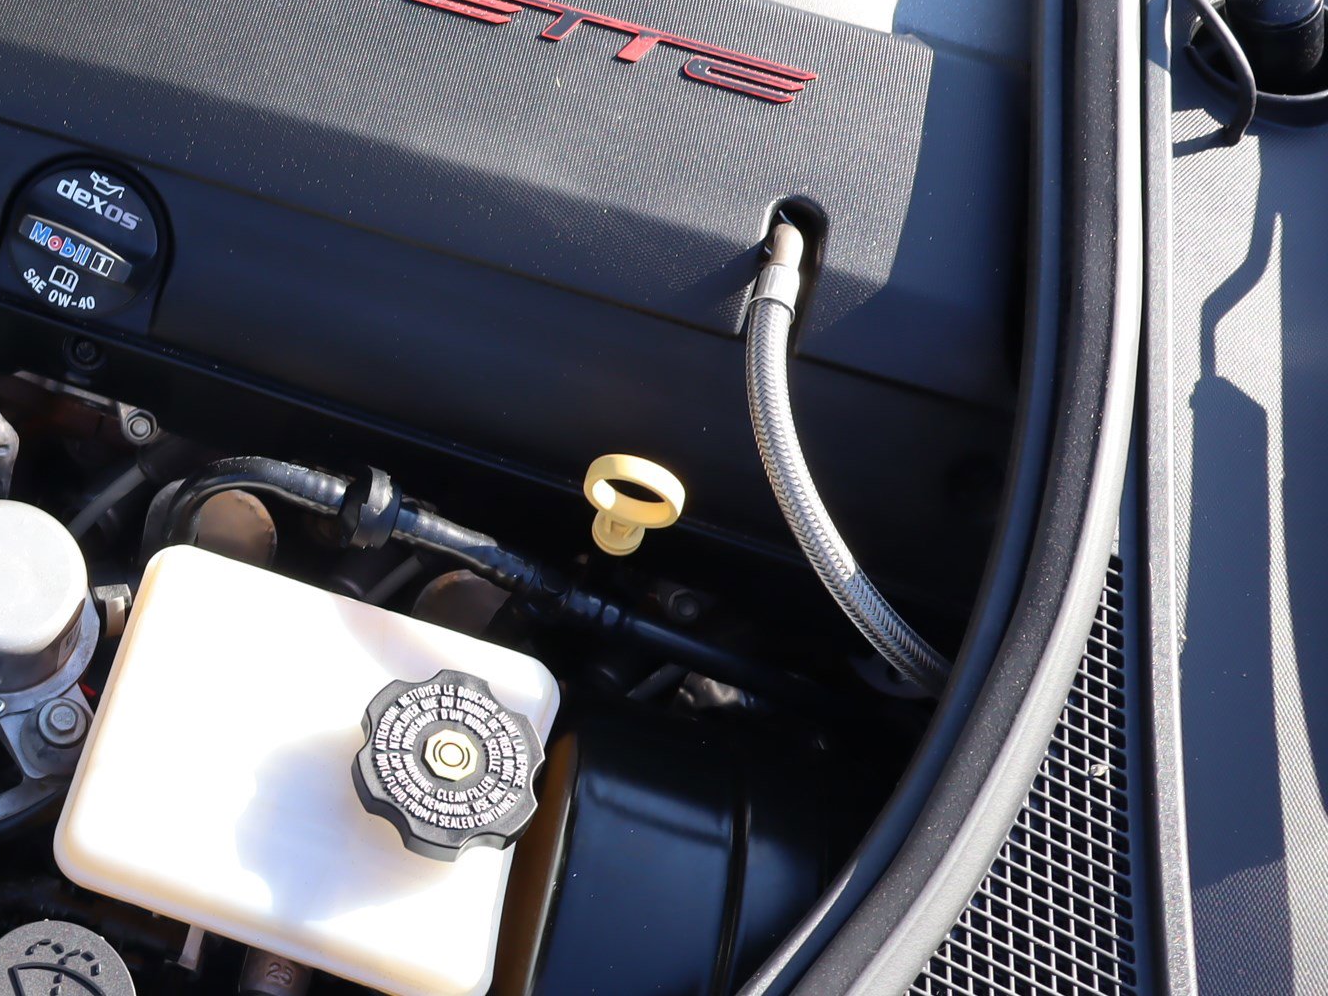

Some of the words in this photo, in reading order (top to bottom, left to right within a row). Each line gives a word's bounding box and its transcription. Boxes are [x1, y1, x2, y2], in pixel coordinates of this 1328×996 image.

[57, 179, 139, 231] dexos
[29, 221, 91, 266] Mobil
[23, 268, 47, 294] SAE
[48, 290, 95, 310] 0W-40
[397, 684, 441, 707] NETTOYER
[441, 695, 454, 708] DU
[443, 684, 455, 696] LE
[457, 685, 498, 714] BOUCHON
[420, 696, 439, 710] QUE
[456, 698, 491, 722] LIQUIDE
[375, 705, 401, 751] ATTENTION:
[402, 708, 438, 750] PROVENANT
[441, 708, 463, 722] D'UN
[464, 713, 492, 739] BIDON
[487, 717, 502, 733] DE
[495, 711, 521, 737] AVANT
[495, 730, 514, 757] FREIN
[512, 739, 525, 752] LA
[389, 752, 403, 770] CAP
[501, 759, 515, 781] DOT4
[512, 753, 529, 789] DEPOSE
[375, 753, 391, 777] DOT4
[384, 775, 408, 802] FLUID
[403, 797, 431, 822] FROM
[429, 812, 437, 824] A
[438, 815, 475, 829] SEALED
[474, 792, 521, 825] CONTAINER.
[394, 769, 425, 802] BEFORE
[436, 788, 468, 802] CLEAN
[466, 775, 495, 801] FILLER
[487, 781, 508, 804] ONLY
[422, 794, 474, 816] REMOVING.
[472, 796, 492, 813] USE
